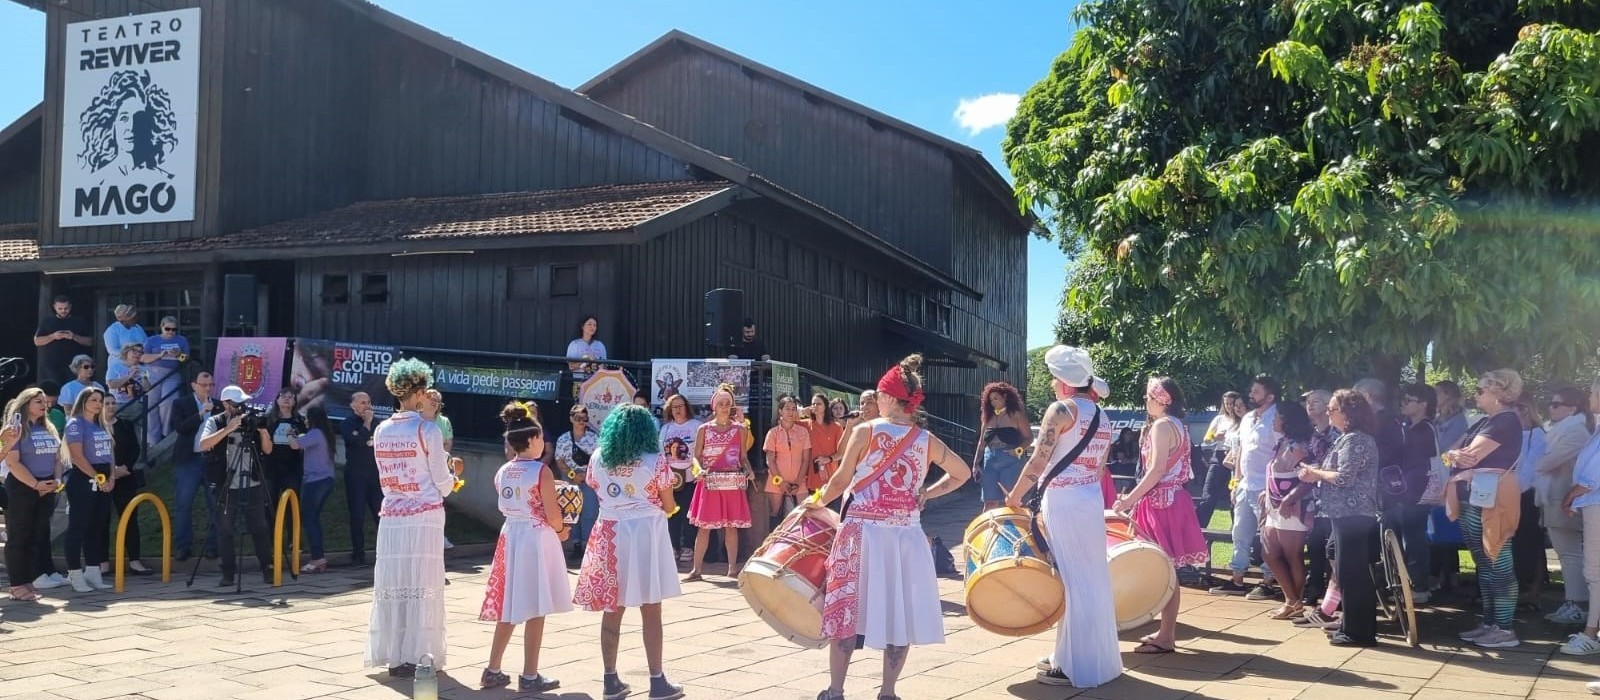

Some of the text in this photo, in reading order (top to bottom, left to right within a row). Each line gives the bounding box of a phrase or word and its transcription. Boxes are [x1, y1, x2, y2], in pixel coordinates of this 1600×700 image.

[81, 17, 182, 43] TEATRO
[79, 40, 181, 71] REVIVER
[332, 371, 363, 384] SIM!
[436, 369, 556, 393] A vida pede passagem
